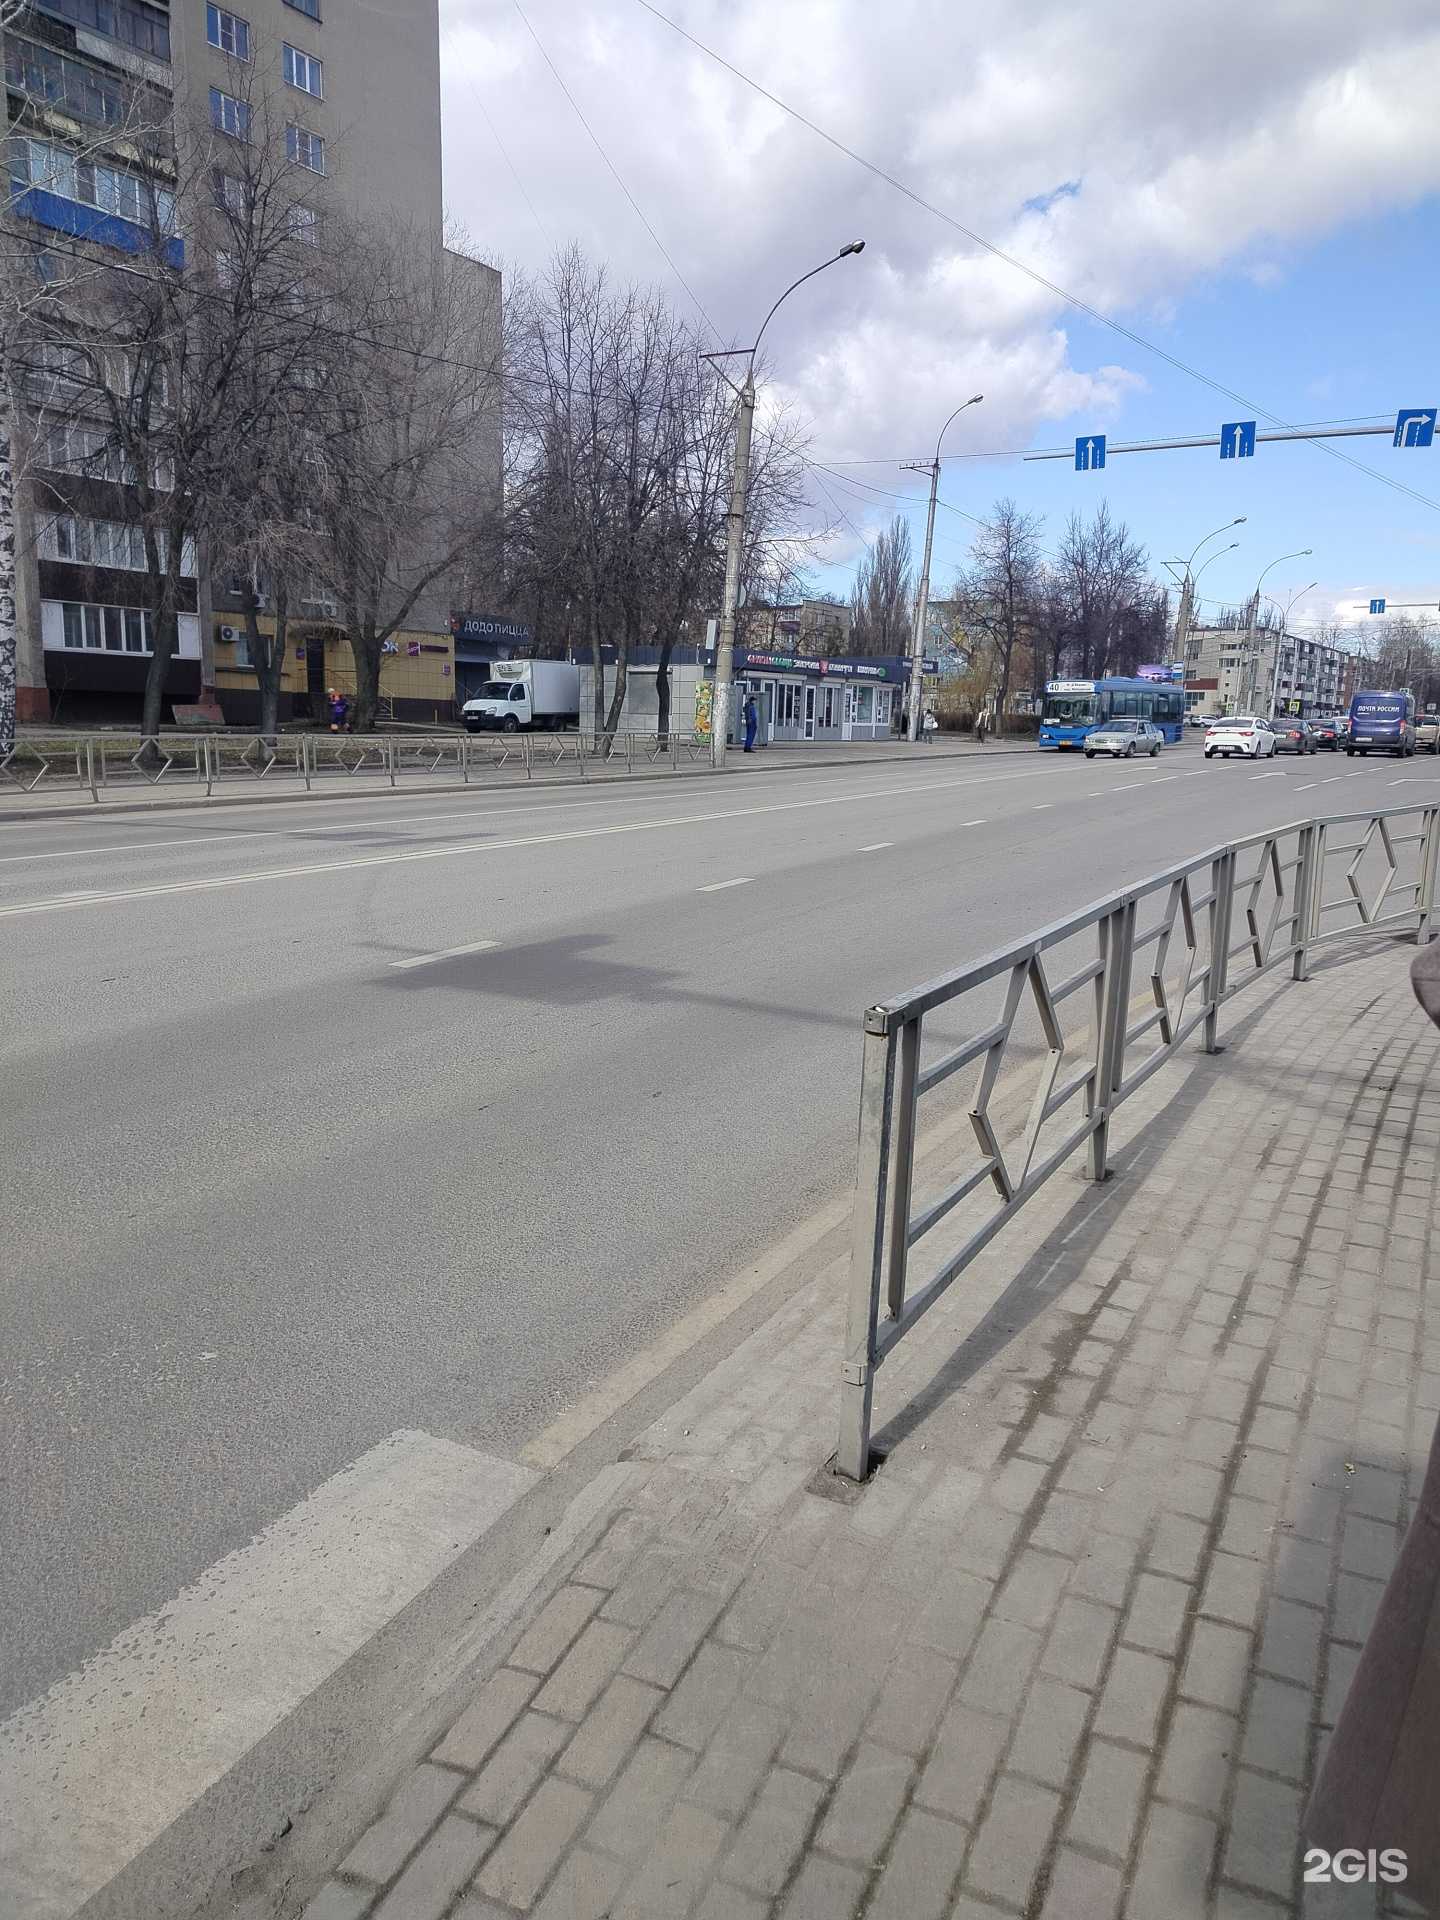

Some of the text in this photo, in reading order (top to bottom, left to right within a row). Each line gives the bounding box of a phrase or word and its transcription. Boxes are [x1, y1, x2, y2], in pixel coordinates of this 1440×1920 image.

[464, 620, 529, 637] ДОДО ПИЦЦА
[1049, 683, 1060, 691] 40
